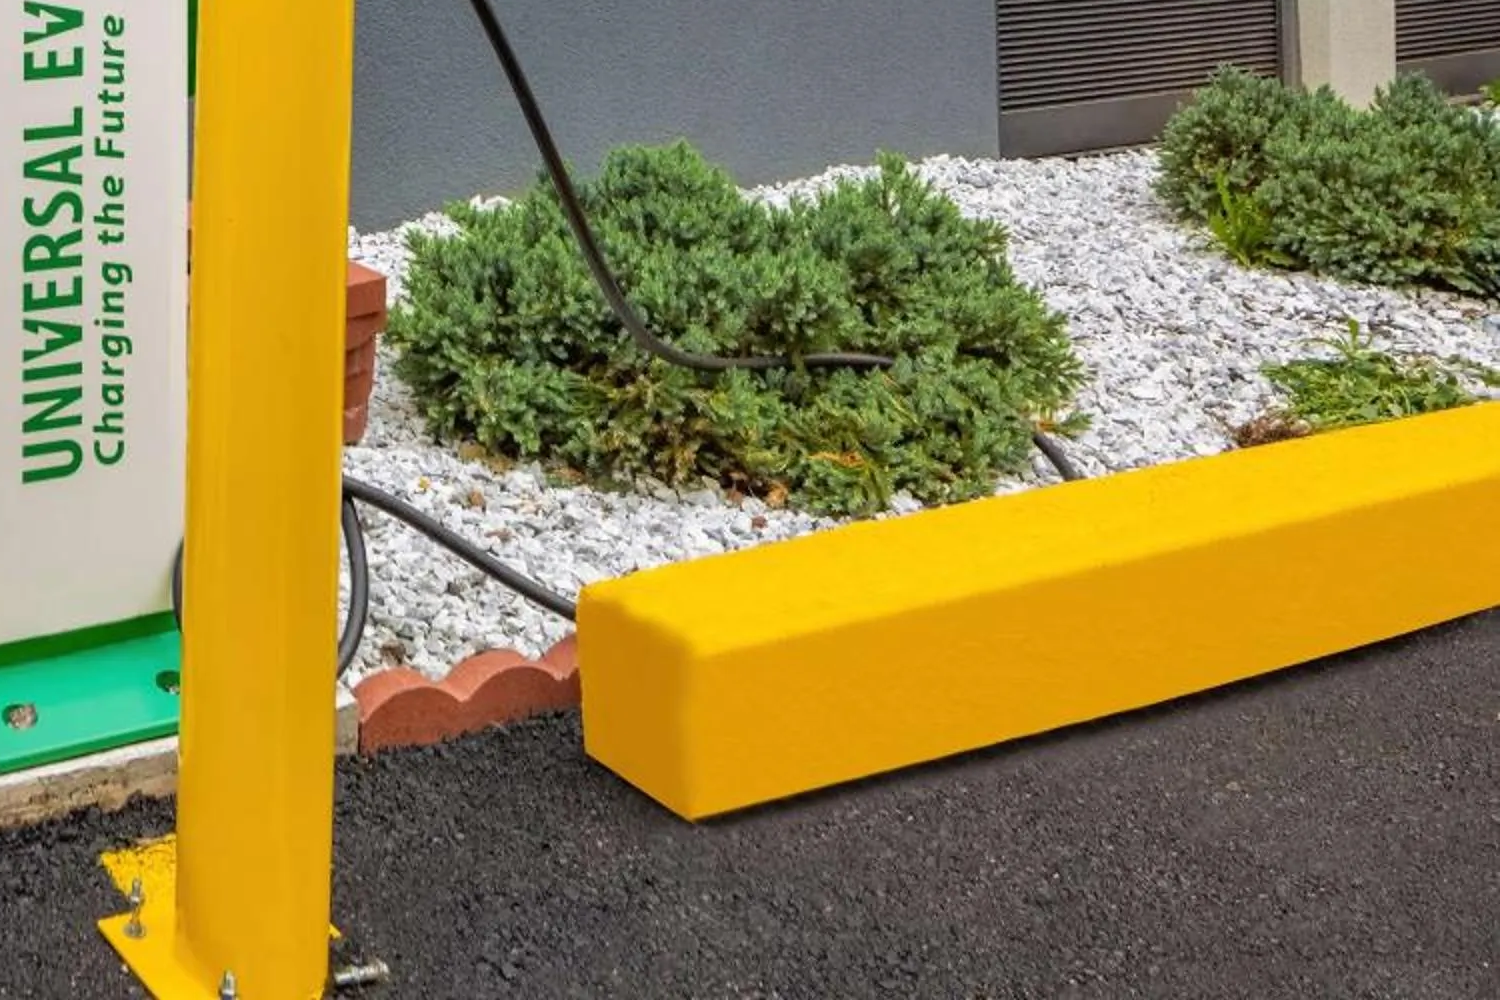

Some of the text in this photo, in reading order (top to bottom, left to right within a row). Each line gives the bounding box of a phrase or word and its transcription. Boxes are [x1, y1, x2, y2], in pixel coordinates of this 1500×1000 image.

[21, 0, 85, 485] UNIVERSAL EV
[93, 14, 133, 466] Charging the Future
